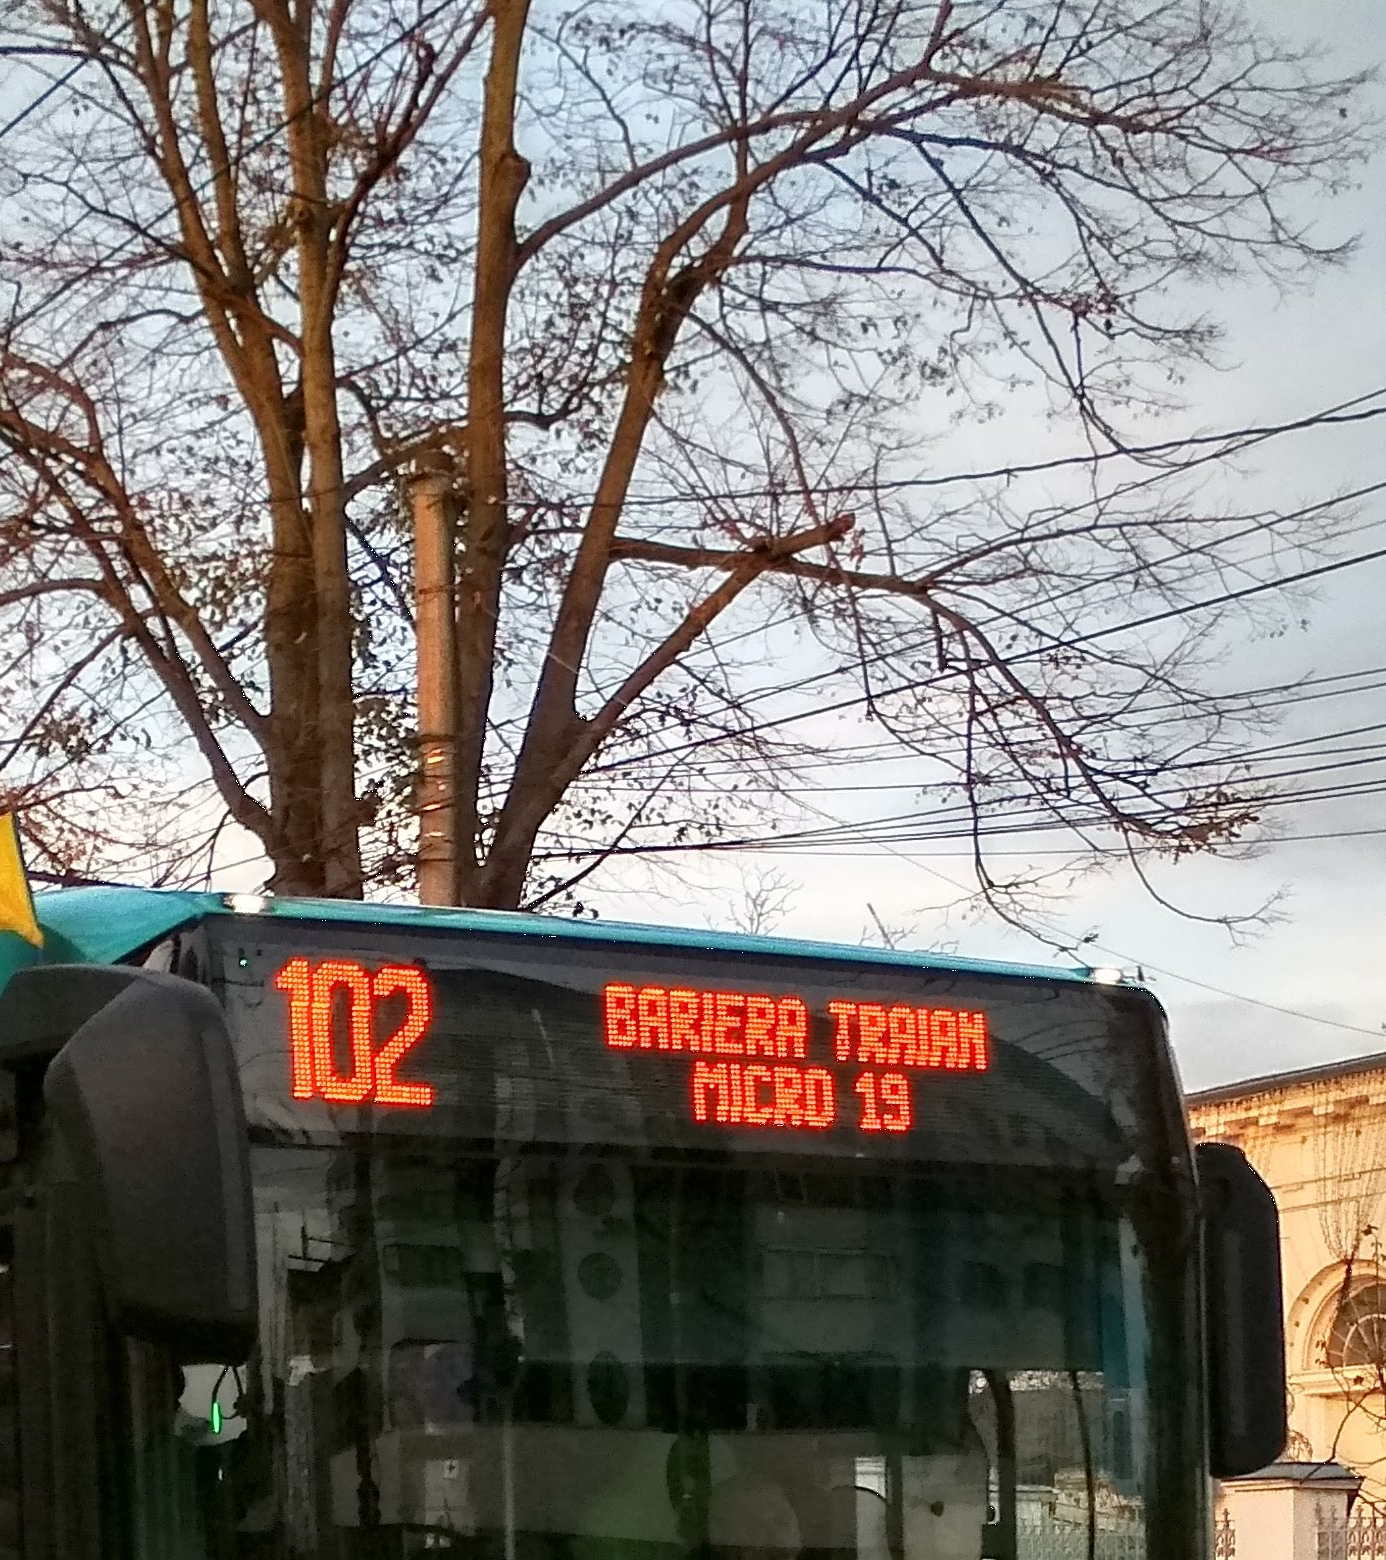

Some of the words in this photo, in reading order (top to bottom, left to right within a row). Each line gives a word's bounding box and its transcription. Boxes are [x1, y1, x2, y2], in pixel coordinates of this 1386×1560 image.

[273, 956, 435, 1109] 102
[602, 983, 809, 1060] BARIERA
[827, 999, 989, 1072] TRAIAN
[693, 1060, 837, 1129] MICRO
[853, 1070, 913, 1132] 19
